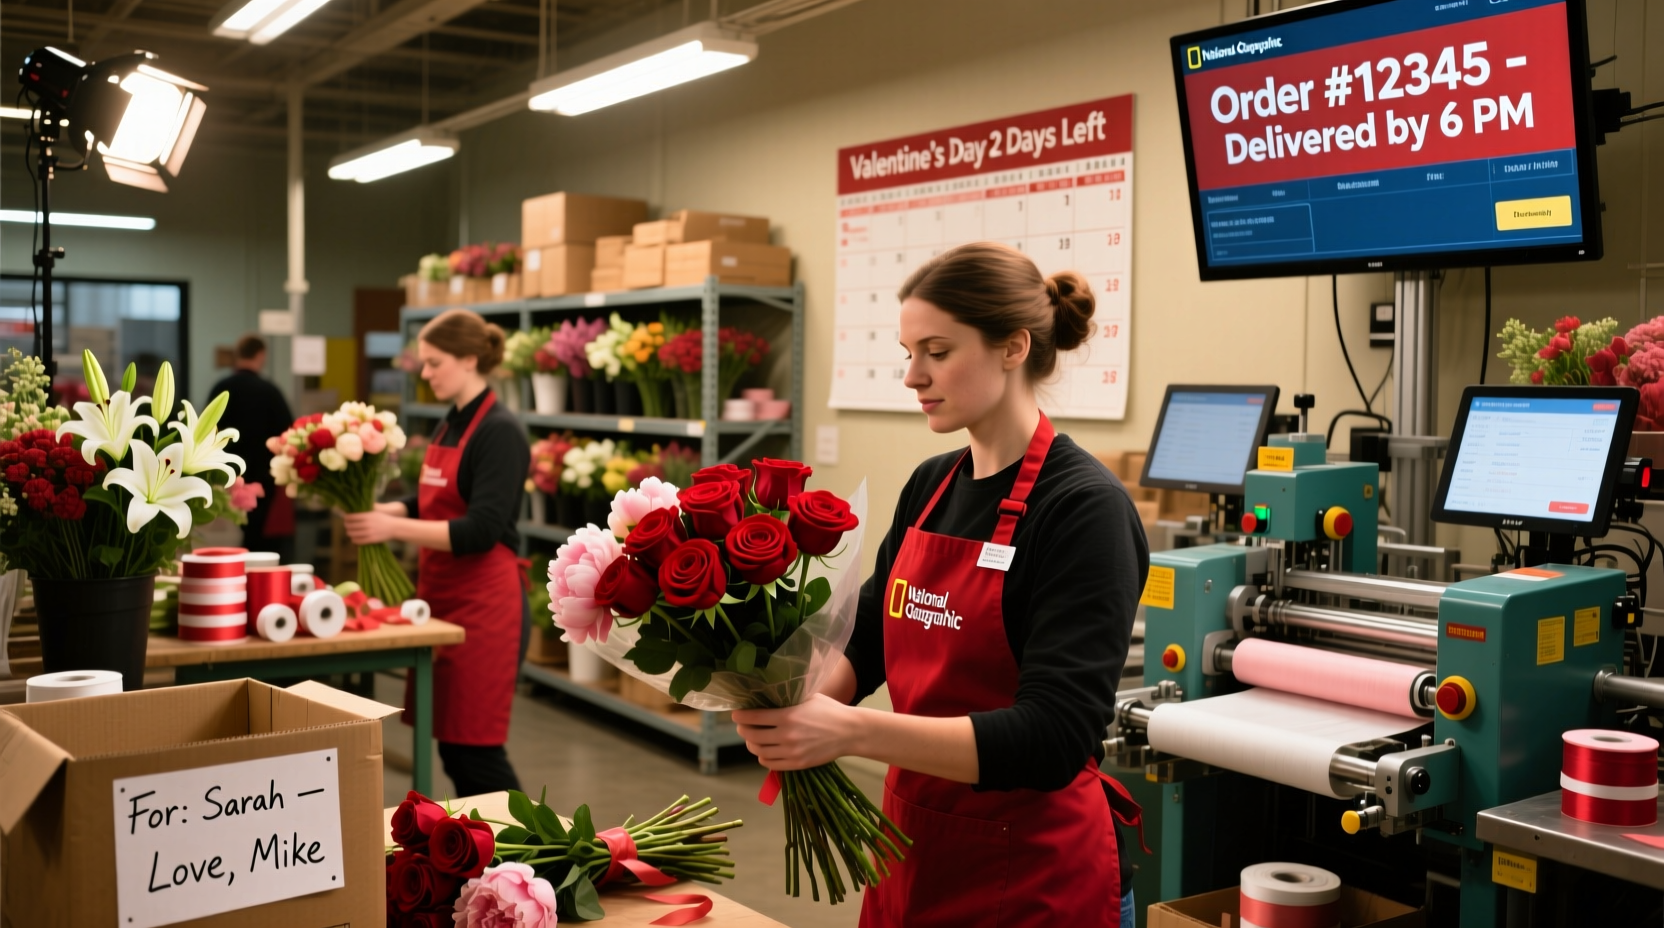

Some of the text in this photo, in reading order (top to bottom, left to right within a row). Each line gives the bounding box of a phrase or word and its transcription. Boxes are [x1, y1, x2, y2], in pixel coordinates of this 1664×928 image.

[1211, 77, 1315, 124] Order
[1325, 41, 1491, 108] #12345
[849, 110, 1107, 180] Valentine's Day 2 Days Left
[1225, 92, 1535, 165] Delivered by 6 PM
[128, 790, 188, 835] For:
[202, 779, 285, 821] Sarah
[148, 831, 326, 893] Love, Mike
